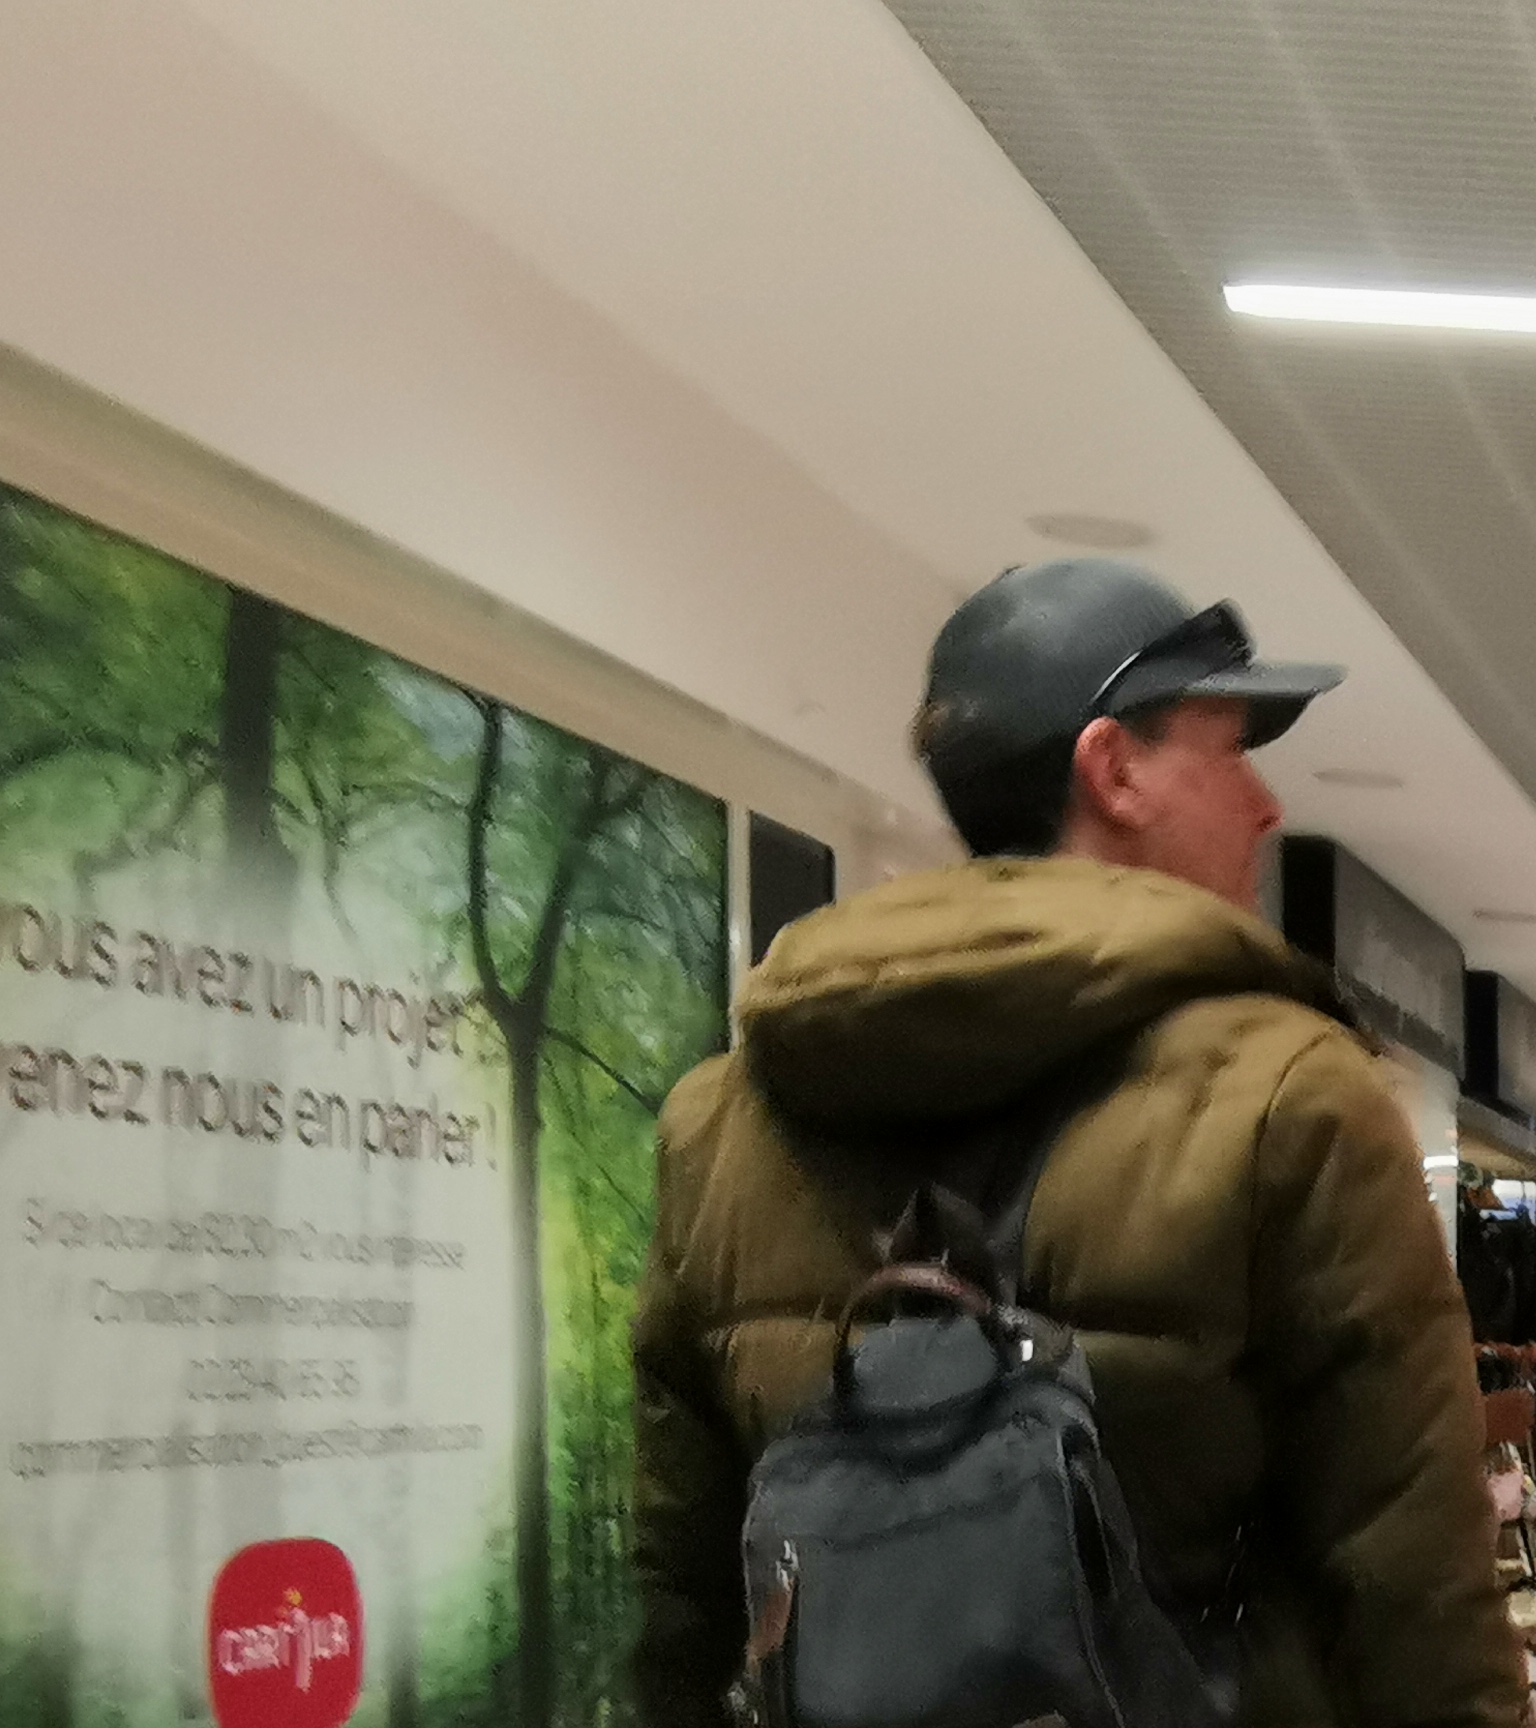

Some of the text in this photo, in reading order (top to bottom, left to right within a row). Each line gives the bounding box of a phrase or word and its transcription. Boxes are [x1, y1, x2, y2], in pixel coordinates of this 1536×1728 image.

[0, 902, 117, 987] ous
[132, 929, 253, 1014] avez
[0, 1044, 149, 1126] enez
[162, 1067, 285, 1144] nous
[293, 1087, 351, 1151] en
